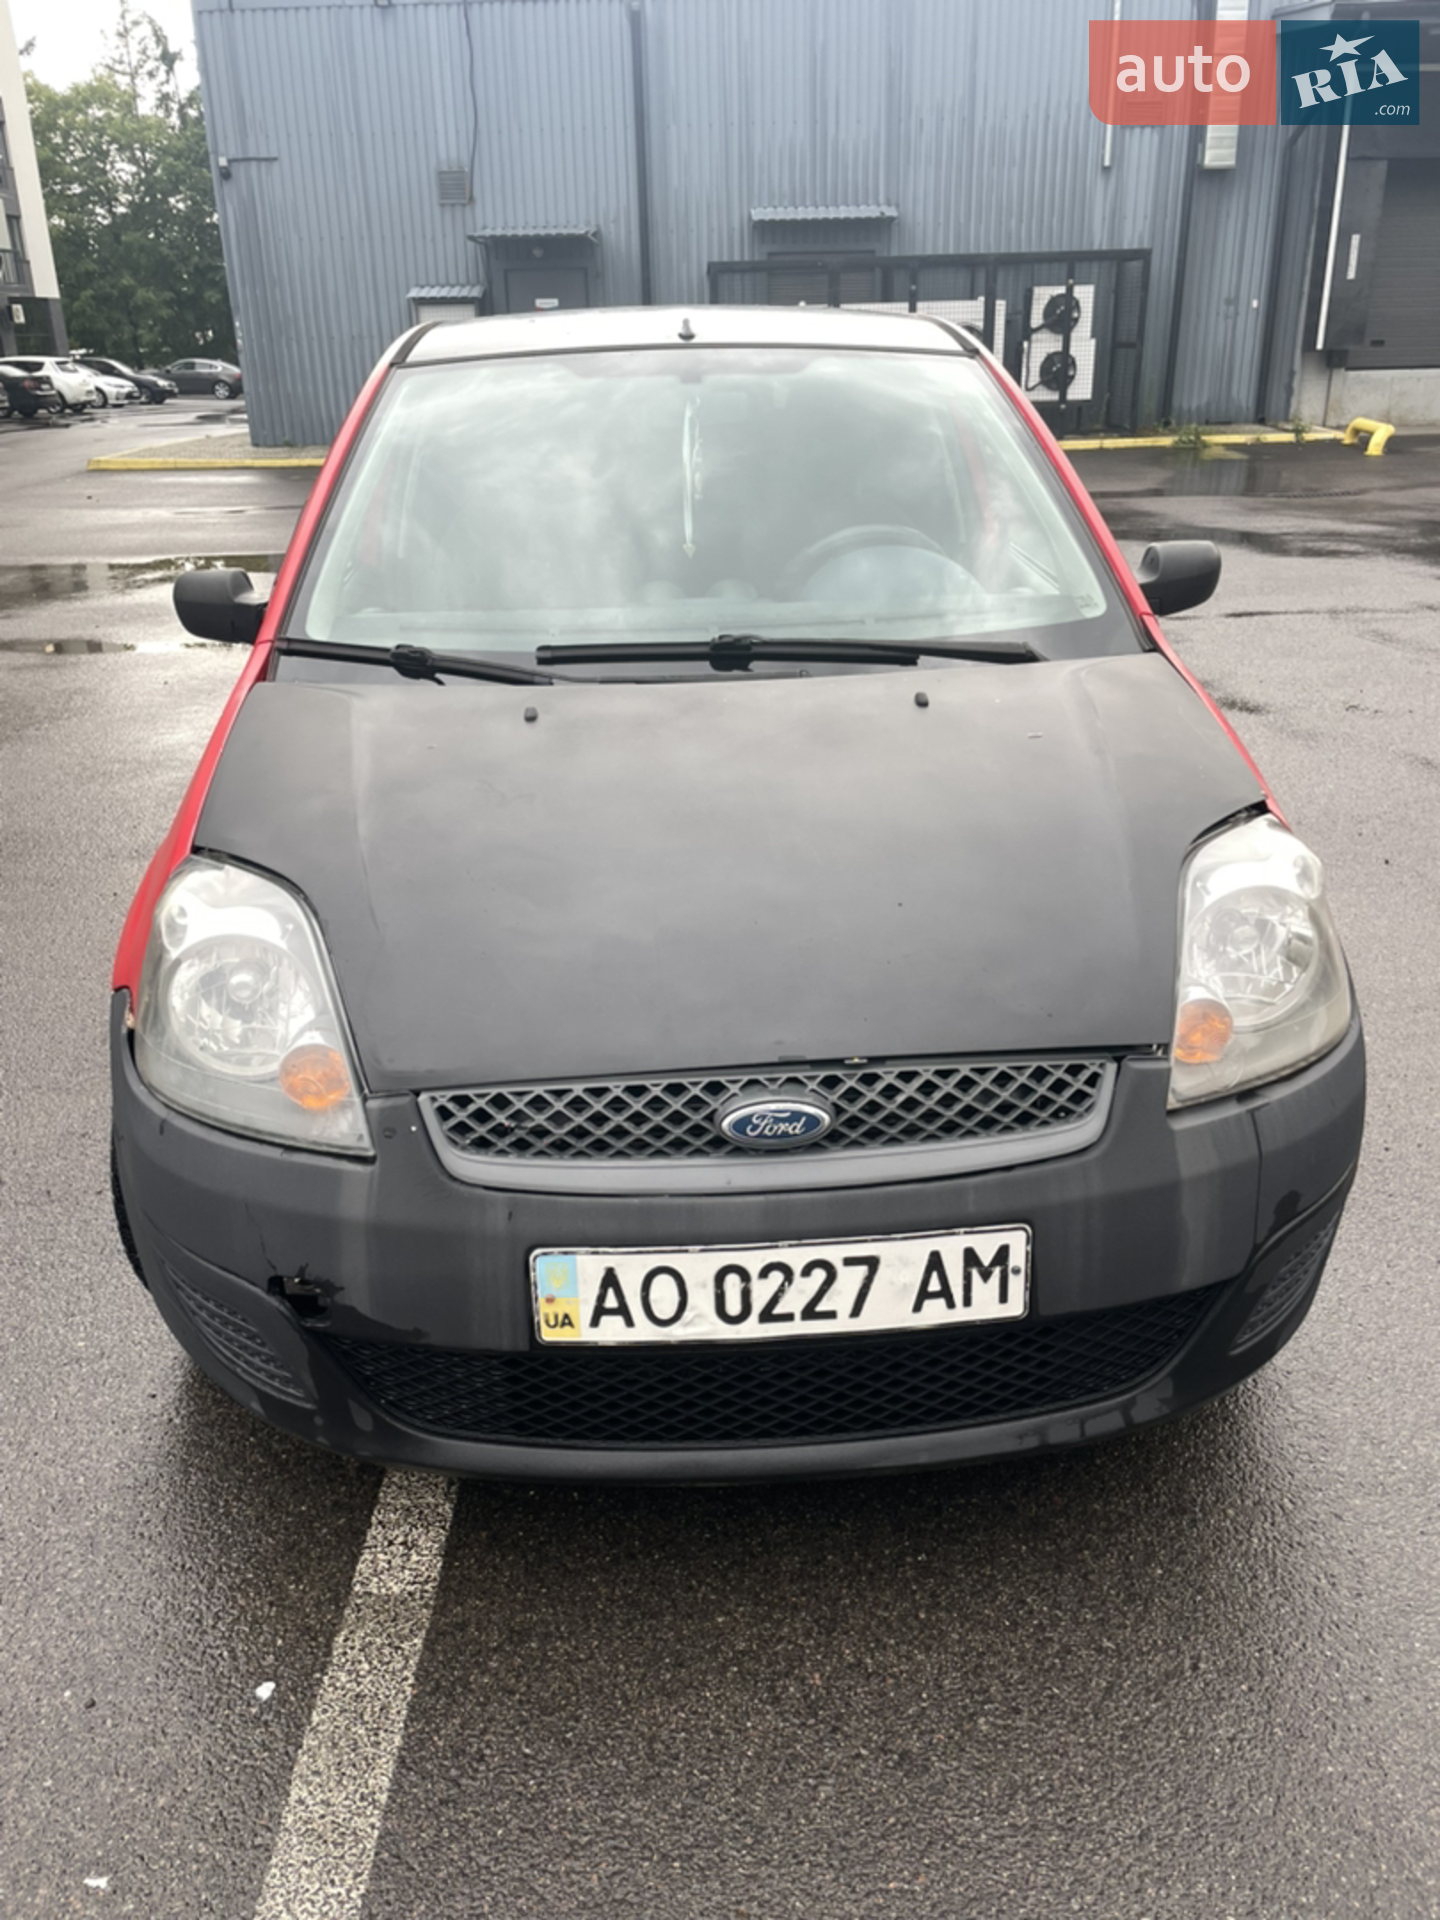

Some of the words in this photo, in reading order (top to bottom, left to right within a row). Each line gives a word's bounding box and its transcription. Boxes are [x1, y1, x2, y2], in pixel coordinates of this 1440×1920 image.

[746, 1110, 807, 1136] Ford
[589, 1265, 689, 1329] AO
[713, 1255, 881, 1326] 0227
[912, 1243, 1011, 1314] AM
[544, 1313, 575, 1331] UA
